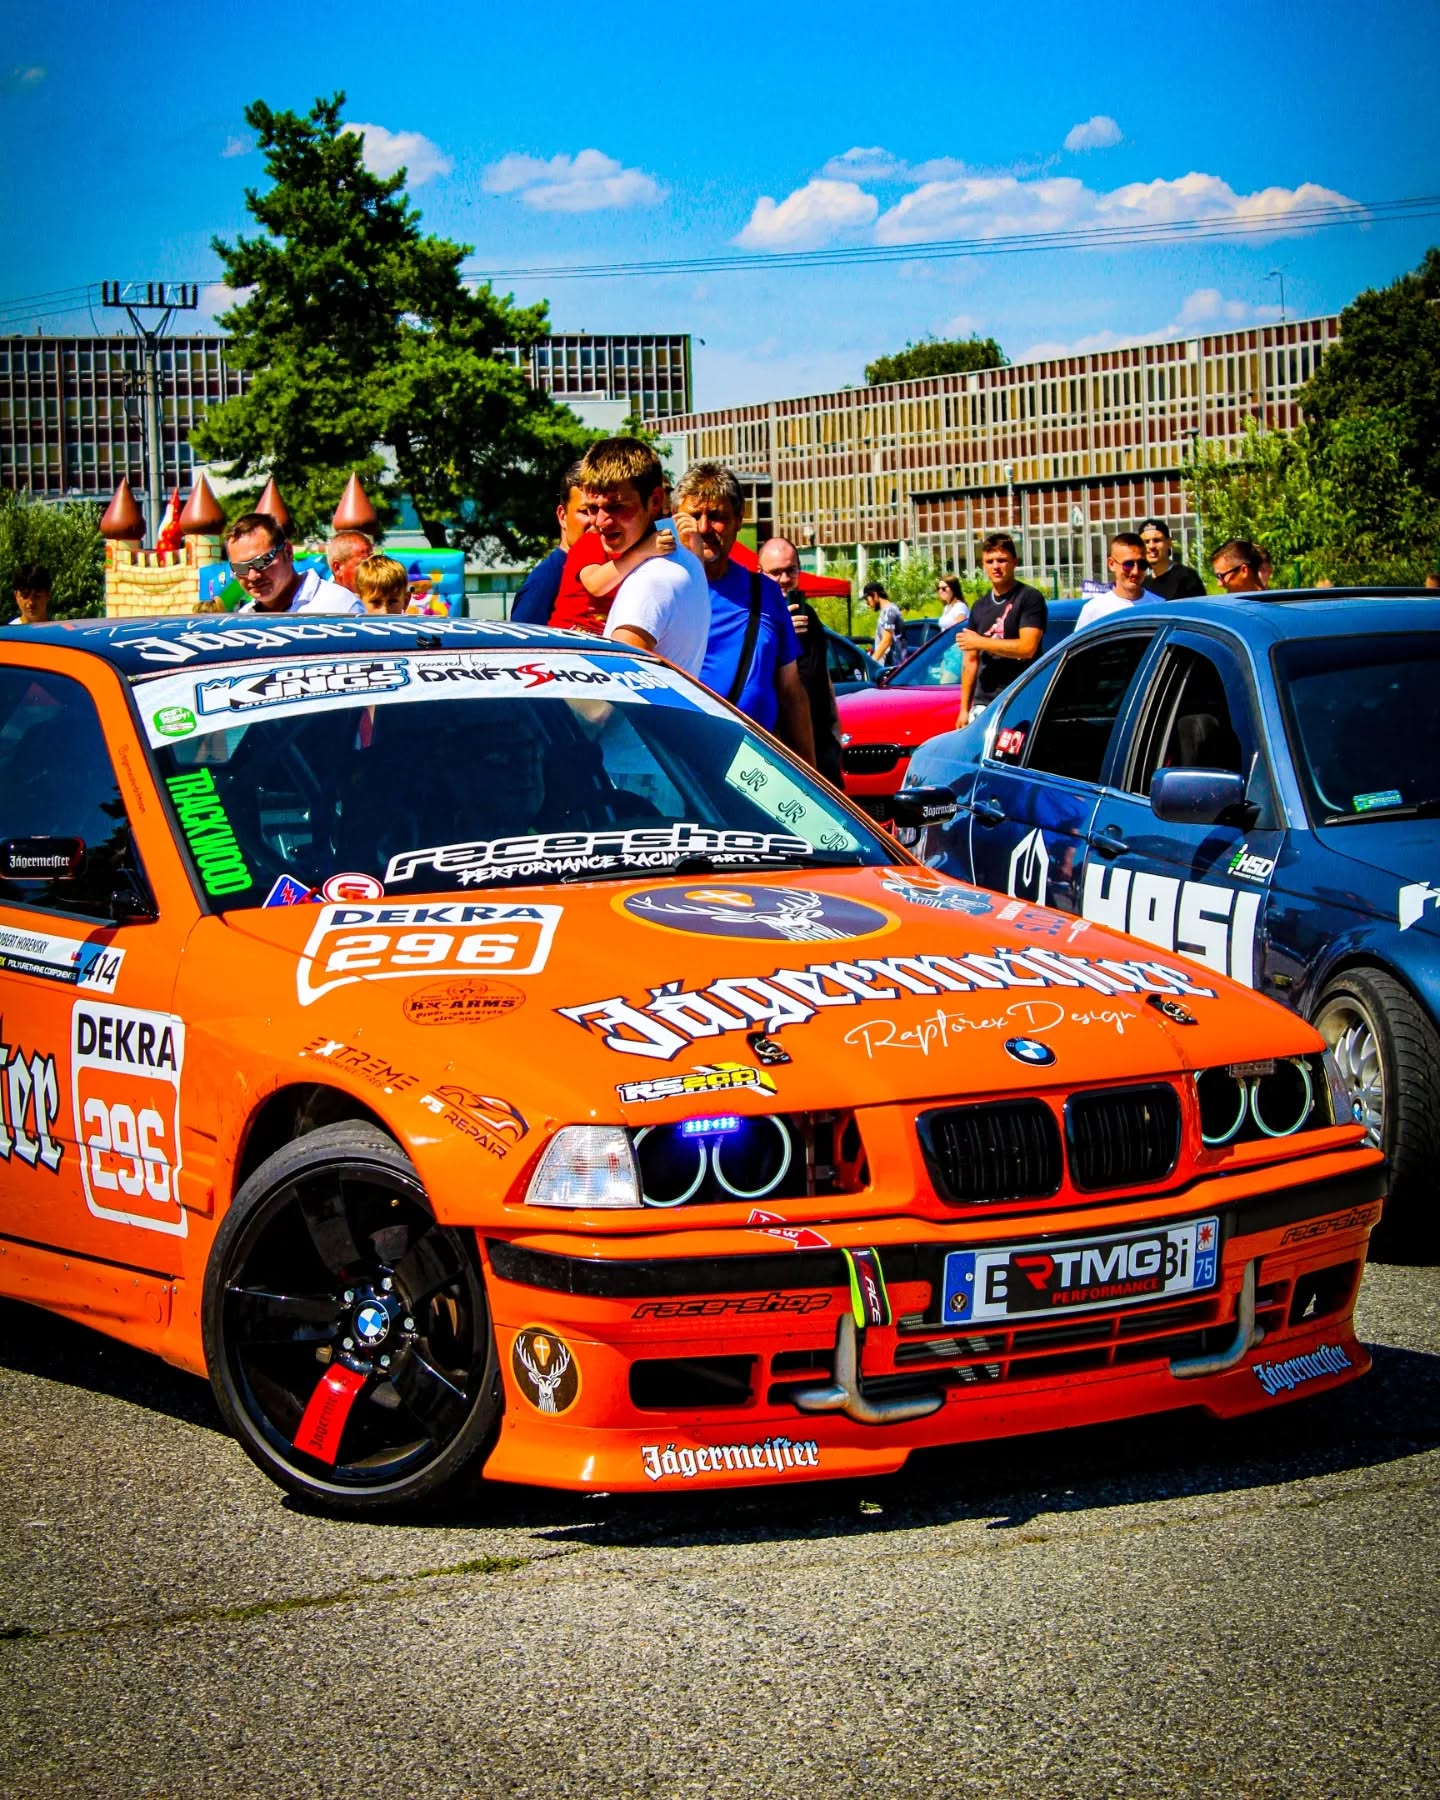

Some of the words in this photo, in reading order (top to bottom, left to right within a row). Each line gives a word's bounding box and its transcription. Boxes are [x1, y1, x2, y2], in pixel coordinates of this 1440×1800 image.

[276, 661, 403, 681] DRIFT
[613, 670, 669, 691] 296
[344, 684, 387, 693] SERIES
[740, 768, 768, 791] JR
[778, 800, 806, 823] JR
[166, 768, 253, 895] TRACKWOOD
[9, 854, 70, 869] Jägermeister
[457, 853, 617, 886] PERFORMANCE
[618, 851, 692, 867] RACIN
[703, 853, 761, 864] ARTS
[1236, 853, 1274, 877] HSD
[330, 906, 545, 926] DEKRA
[324, 933, 520, 973] 296
[83, 952, 121, 985] 414
[552, 943, 1217, 1062] Jägermeister
[77, 1012, 177, 1072] DEKRA
[303, 1036, 420, 1091] EXTREME
[83, 1097, 171, 1202] 296
[444, 1111, 507, 1160] REPAIR
[1196, 1257, 1214, 1282] 75
[1052, 1277, 1160, 1304] PERFORMANCE
[641, 1437, 820, 1482] Jägermeister
